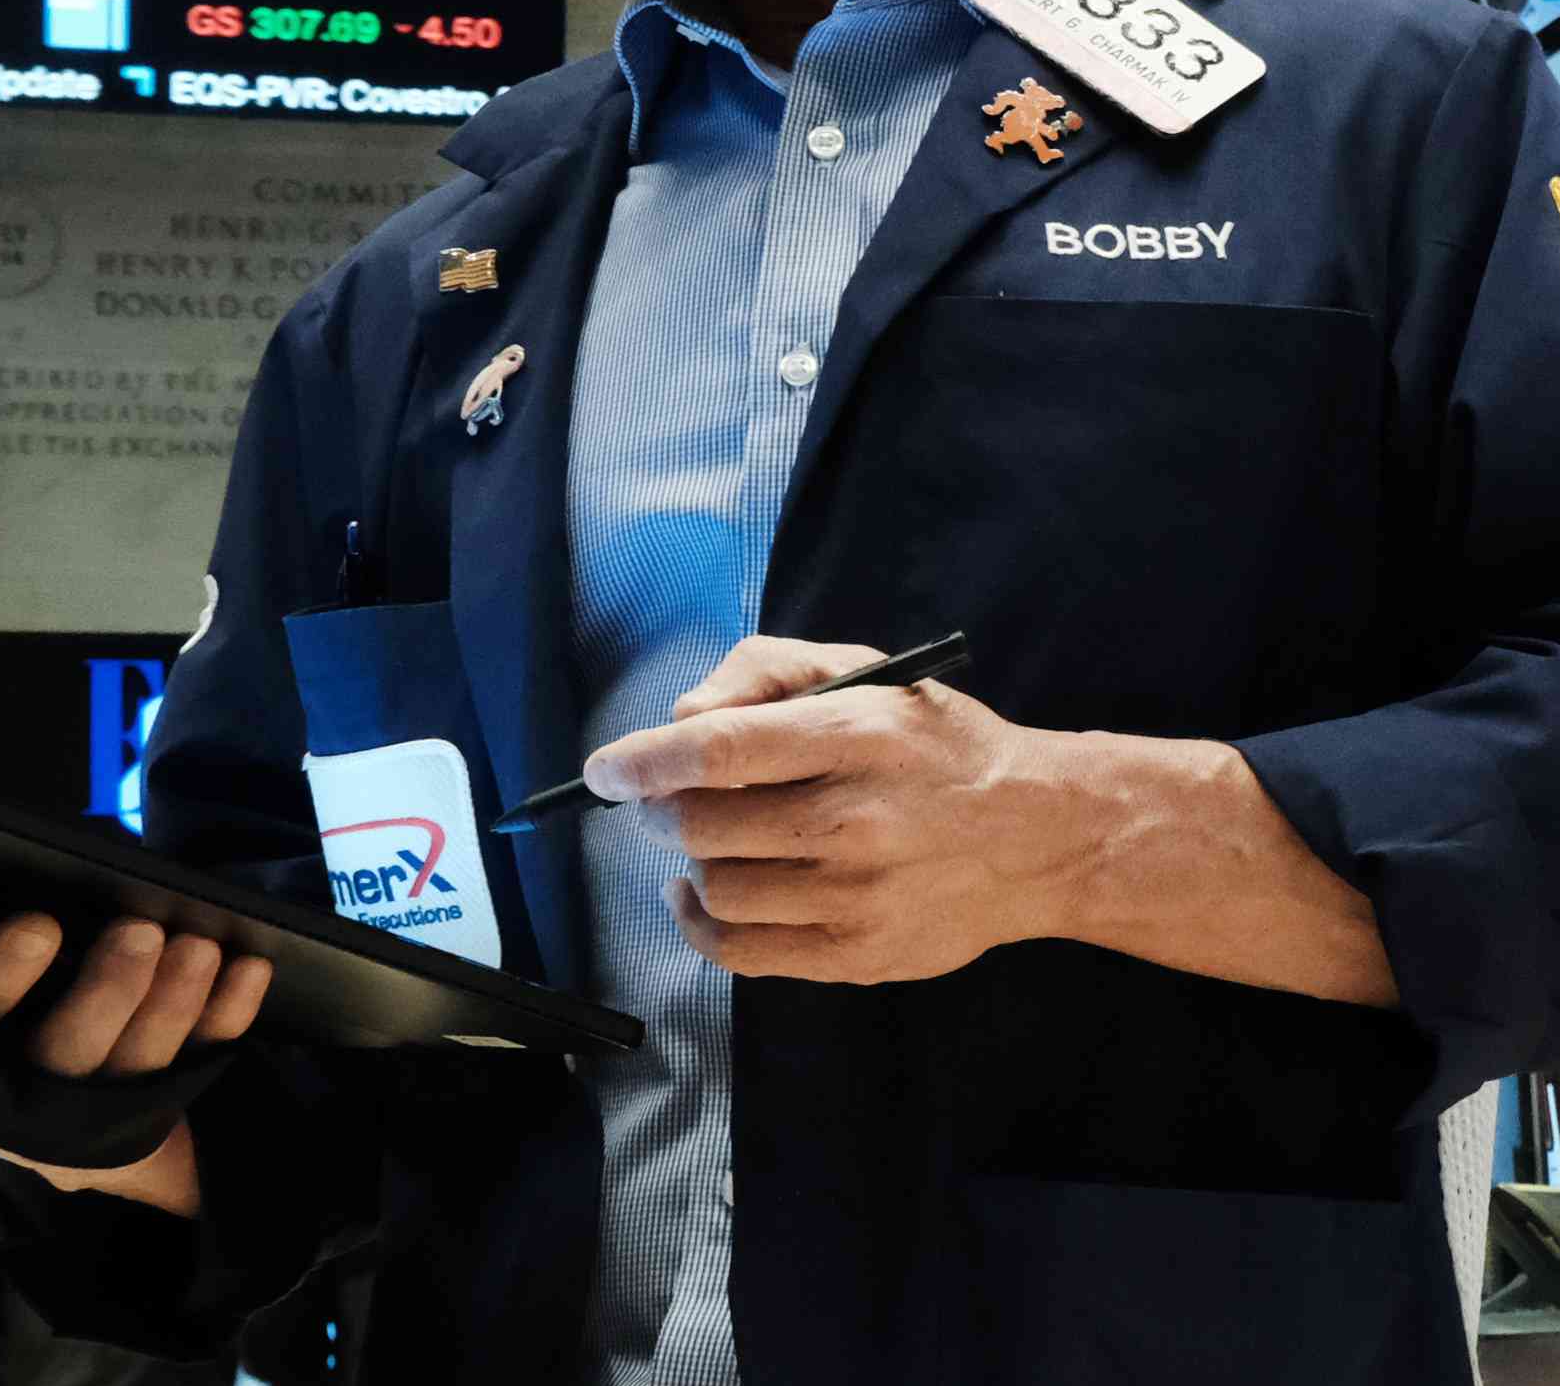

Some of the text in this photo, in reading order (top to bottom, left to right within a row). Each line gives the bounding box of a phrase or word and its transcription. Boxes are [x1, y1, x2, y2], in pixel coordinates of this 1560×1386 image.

[186, 4, 382, 45] GS 307.69
[1091, 34, 1167, 89] CHARMAK
[1045, 221, 1235, 261] BOBBY
